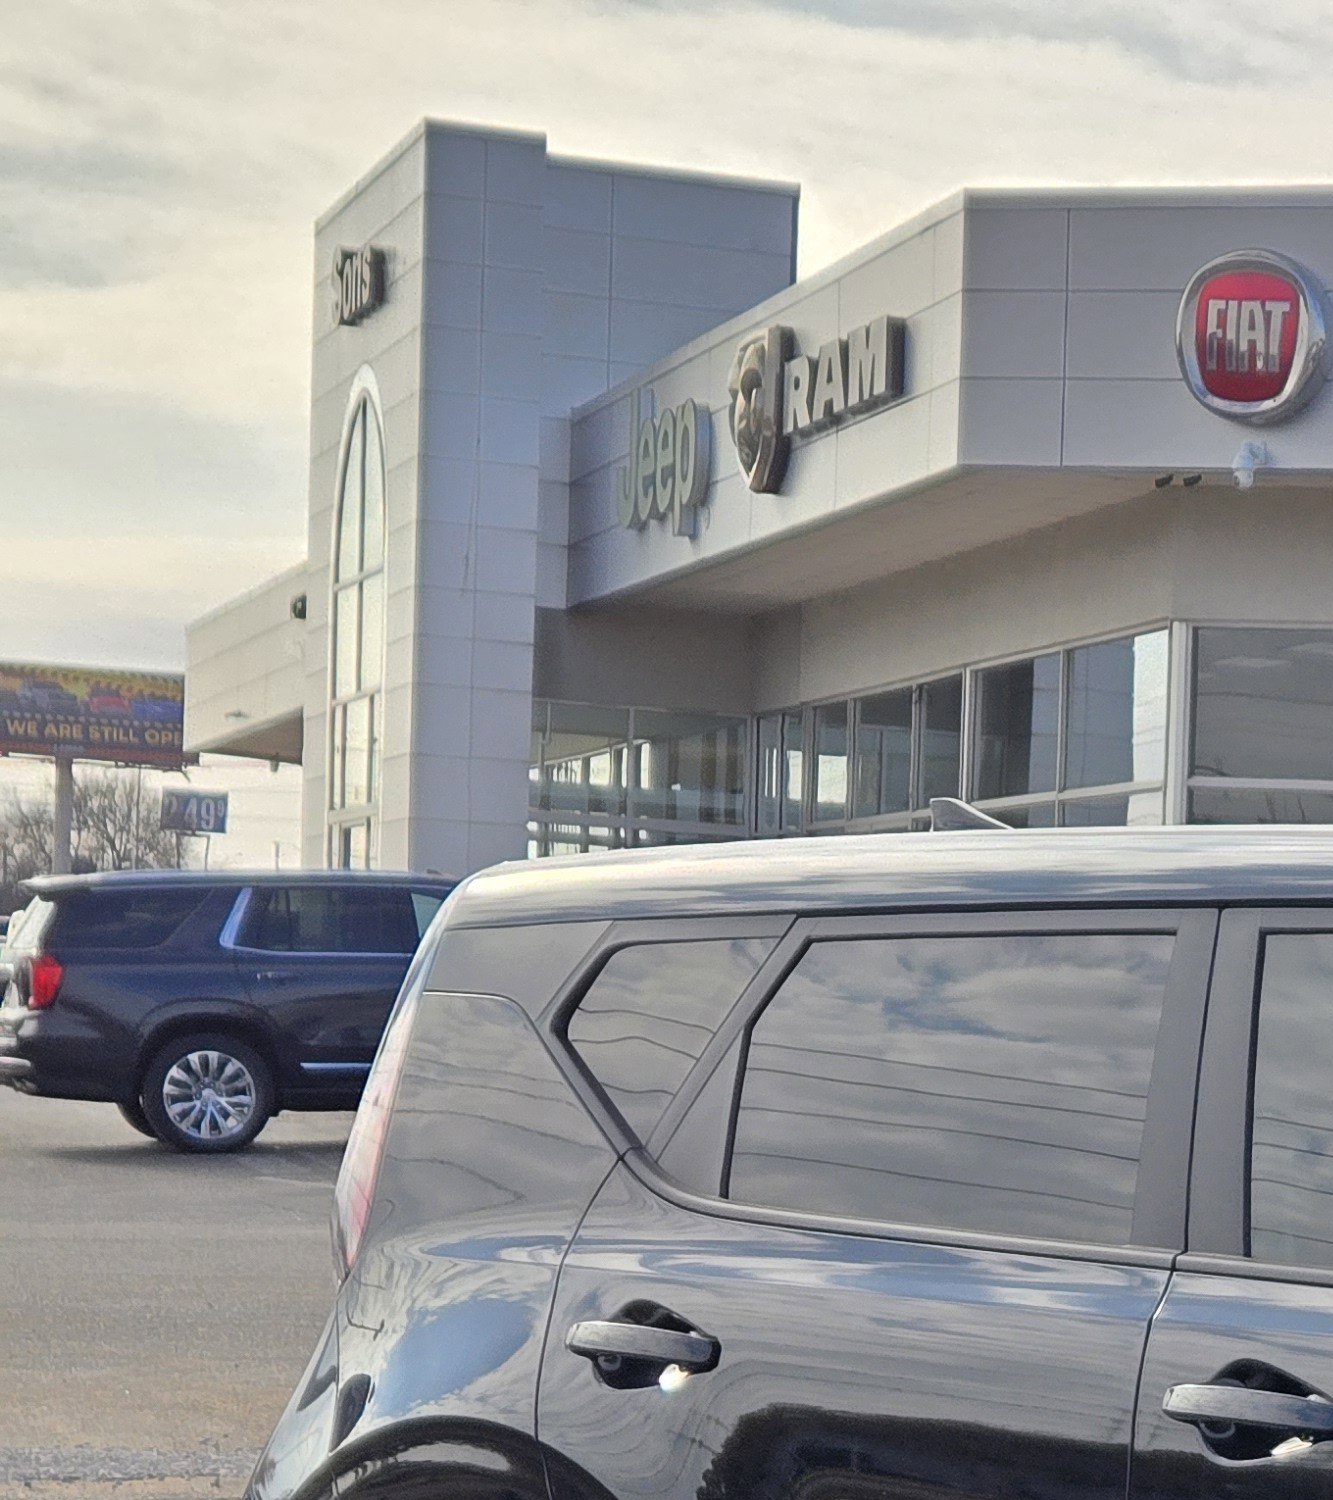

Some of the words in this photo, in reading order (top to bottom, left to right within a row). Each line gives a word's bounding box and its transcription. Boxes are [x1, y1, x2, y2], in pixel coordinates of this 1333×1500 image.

[331, 242, 372, 326] Sons
[782, 314, 890, 436] RAM
[1206, 298, 1291, 373] FIAT
[617, 387, 698, 537] Jeep
[6, 718, 38, 736] WE
[44, 722, 84, 741] ARE
[89, 725, 140, 744] STILL
[144, 728, 183, 746] OPE
